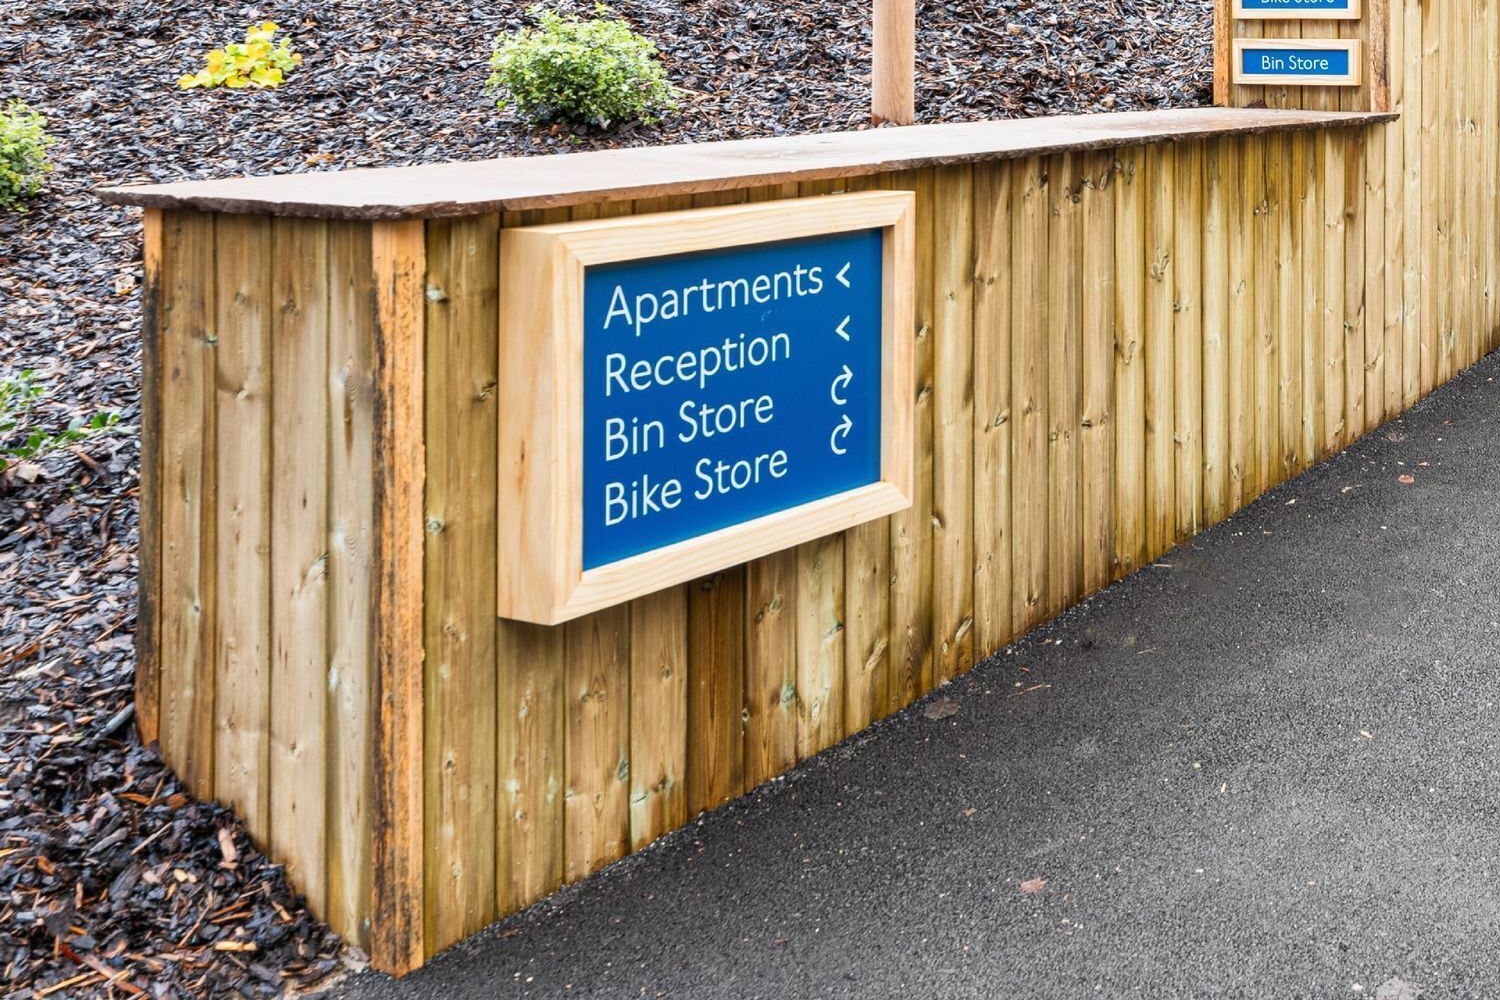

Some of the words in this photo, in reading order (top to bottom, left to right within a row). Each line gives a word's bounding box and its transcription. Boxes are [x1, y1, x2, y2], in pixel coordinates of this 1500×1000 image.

[1261, 55, 1285, 70] Bin
[1288, 55, 1329, 70] Store
[603, 263, 824, 337] Apartments
[604, 331, 791, 398] Reception
[604, 418, 665, 462] Bin
[678, 394, 775, 443] Store
[604, 474, 682, 527] Bike
[694, 449, 789, 501] Store
